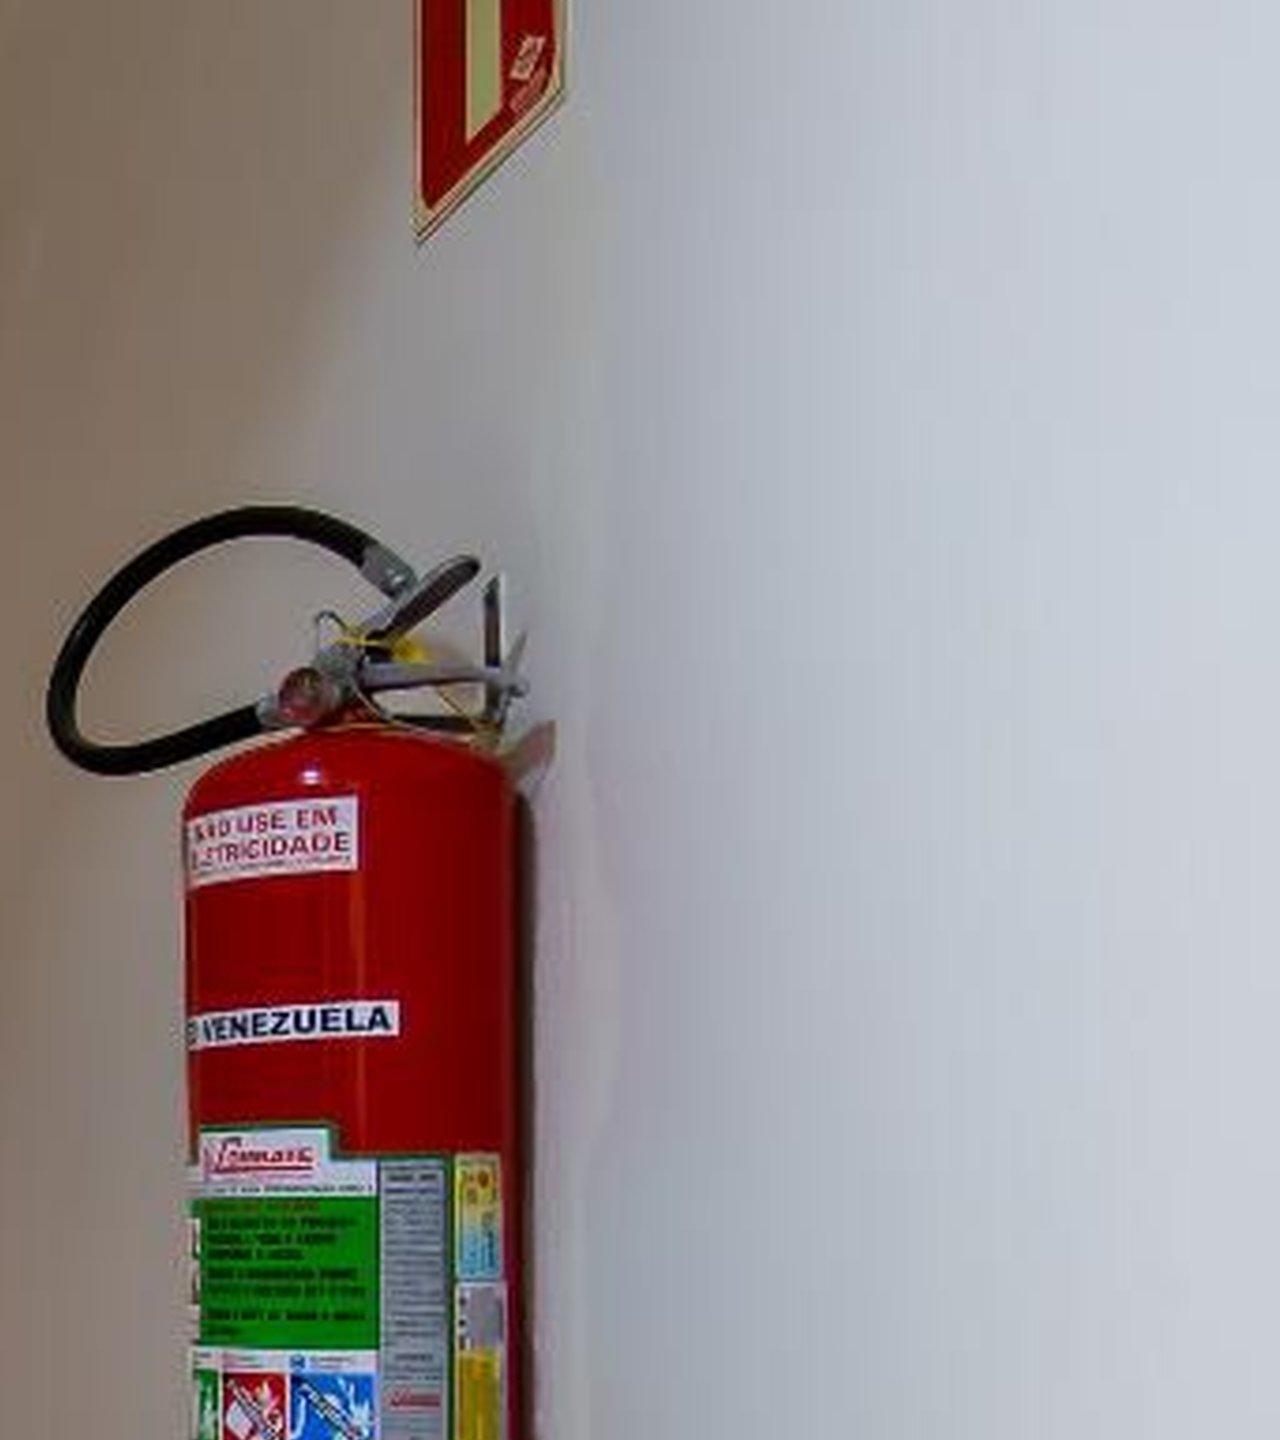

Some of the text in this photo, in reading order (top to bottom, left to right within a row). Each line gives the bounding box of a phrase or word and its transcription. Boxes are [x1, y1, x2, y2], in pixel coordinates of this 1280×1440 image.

[237, 810, 287, 833] USE
[296, 806, 338, 831] EM
[203, 1006, 392, 1042] VENEZUELA
